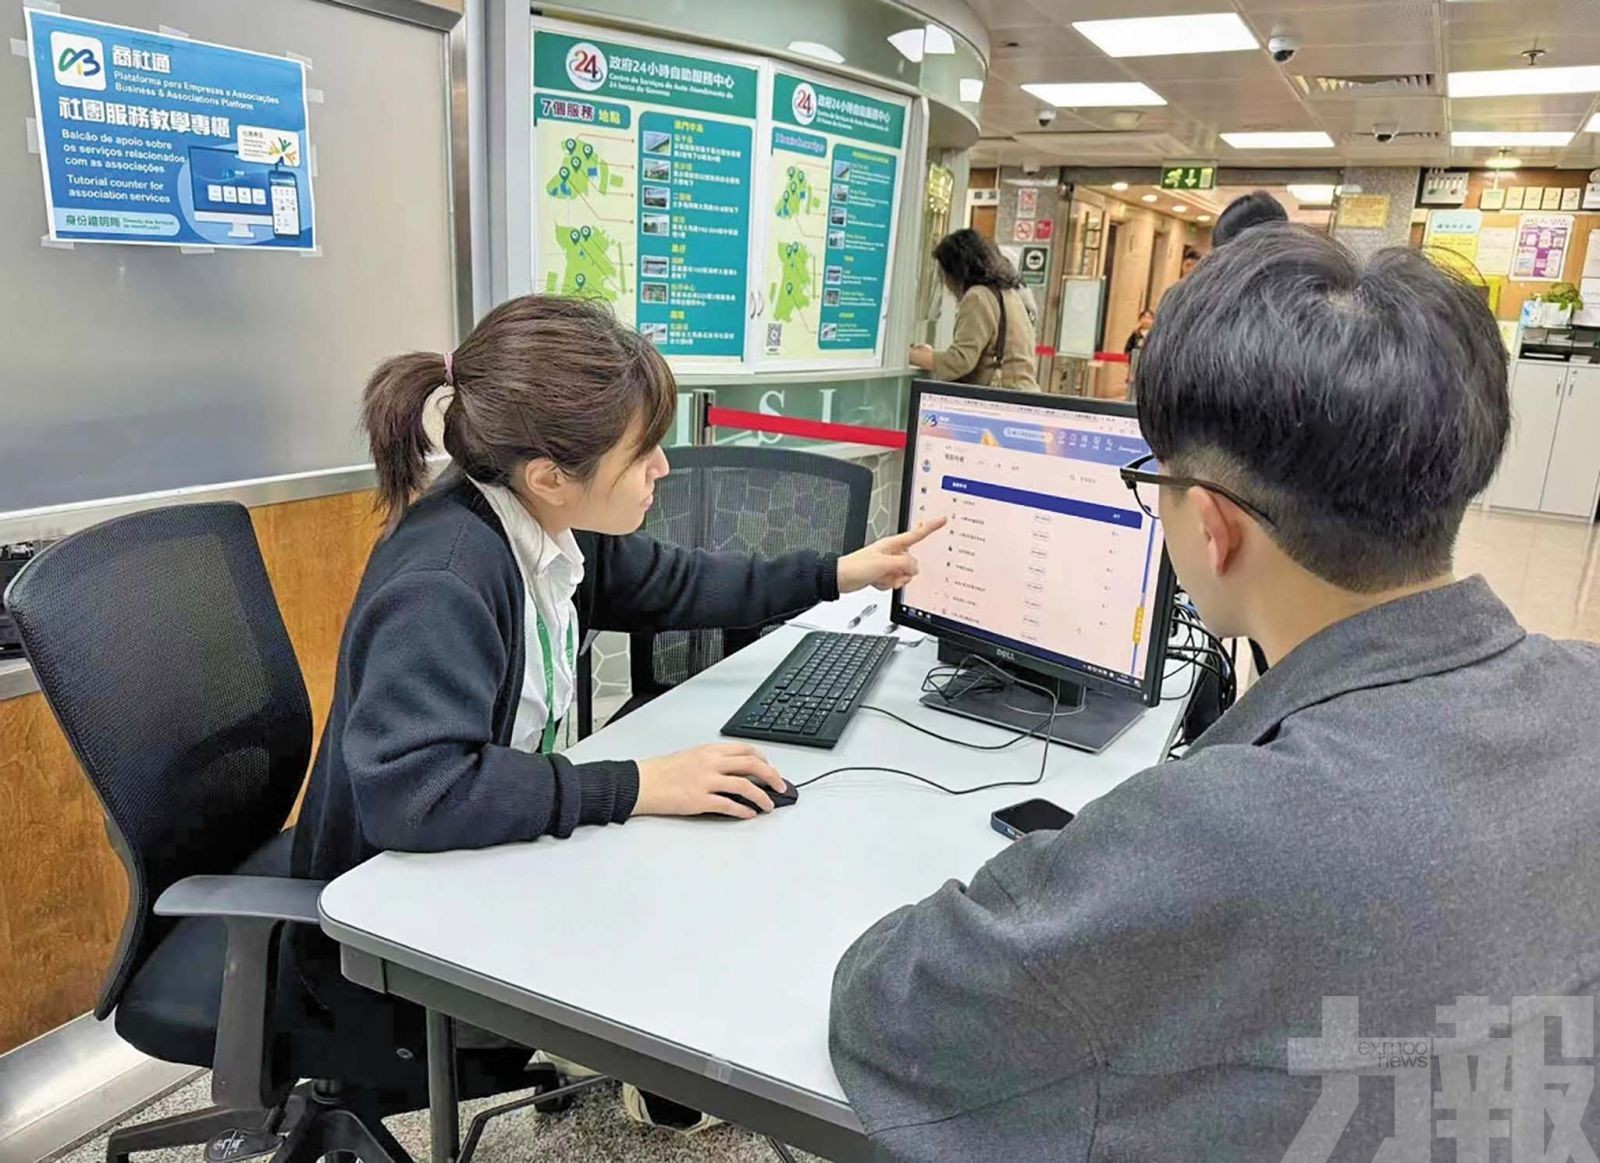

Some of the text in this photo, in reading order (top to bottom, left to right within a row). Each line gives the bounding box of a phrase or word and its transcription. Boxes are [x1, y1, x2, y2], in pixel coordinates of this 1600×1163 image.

[112, 45, 171, 74] 商社通
[574, 49, 600, 80] 24
[608, 55, 735, 89] 政府24小時自助服務中心
[113, 71, 162, 87] Plataforma
[163, 80, 182, 90] para
[183, 82, 225, 97] Empresas
[232, 90, 280, 105] Associações
[608, 72, 630, 83] Centro
[115, 82, 254, 111] Business & Associations Platform
[797, 88, 812, 116] 24
[58, 96, 231, 139] 社團服務教學專櫃
[541, 98, 621, 125] 7個服務 地點
[61, 128, 173, 150] Balcão de apoio sobre
[63, 144, 186, 164] os serviços relacionados
[65, 157, 165, 174] com as associações
[66, 174, 165, 191] Tutorial counter for
[68, 188, 171, 203] association services
